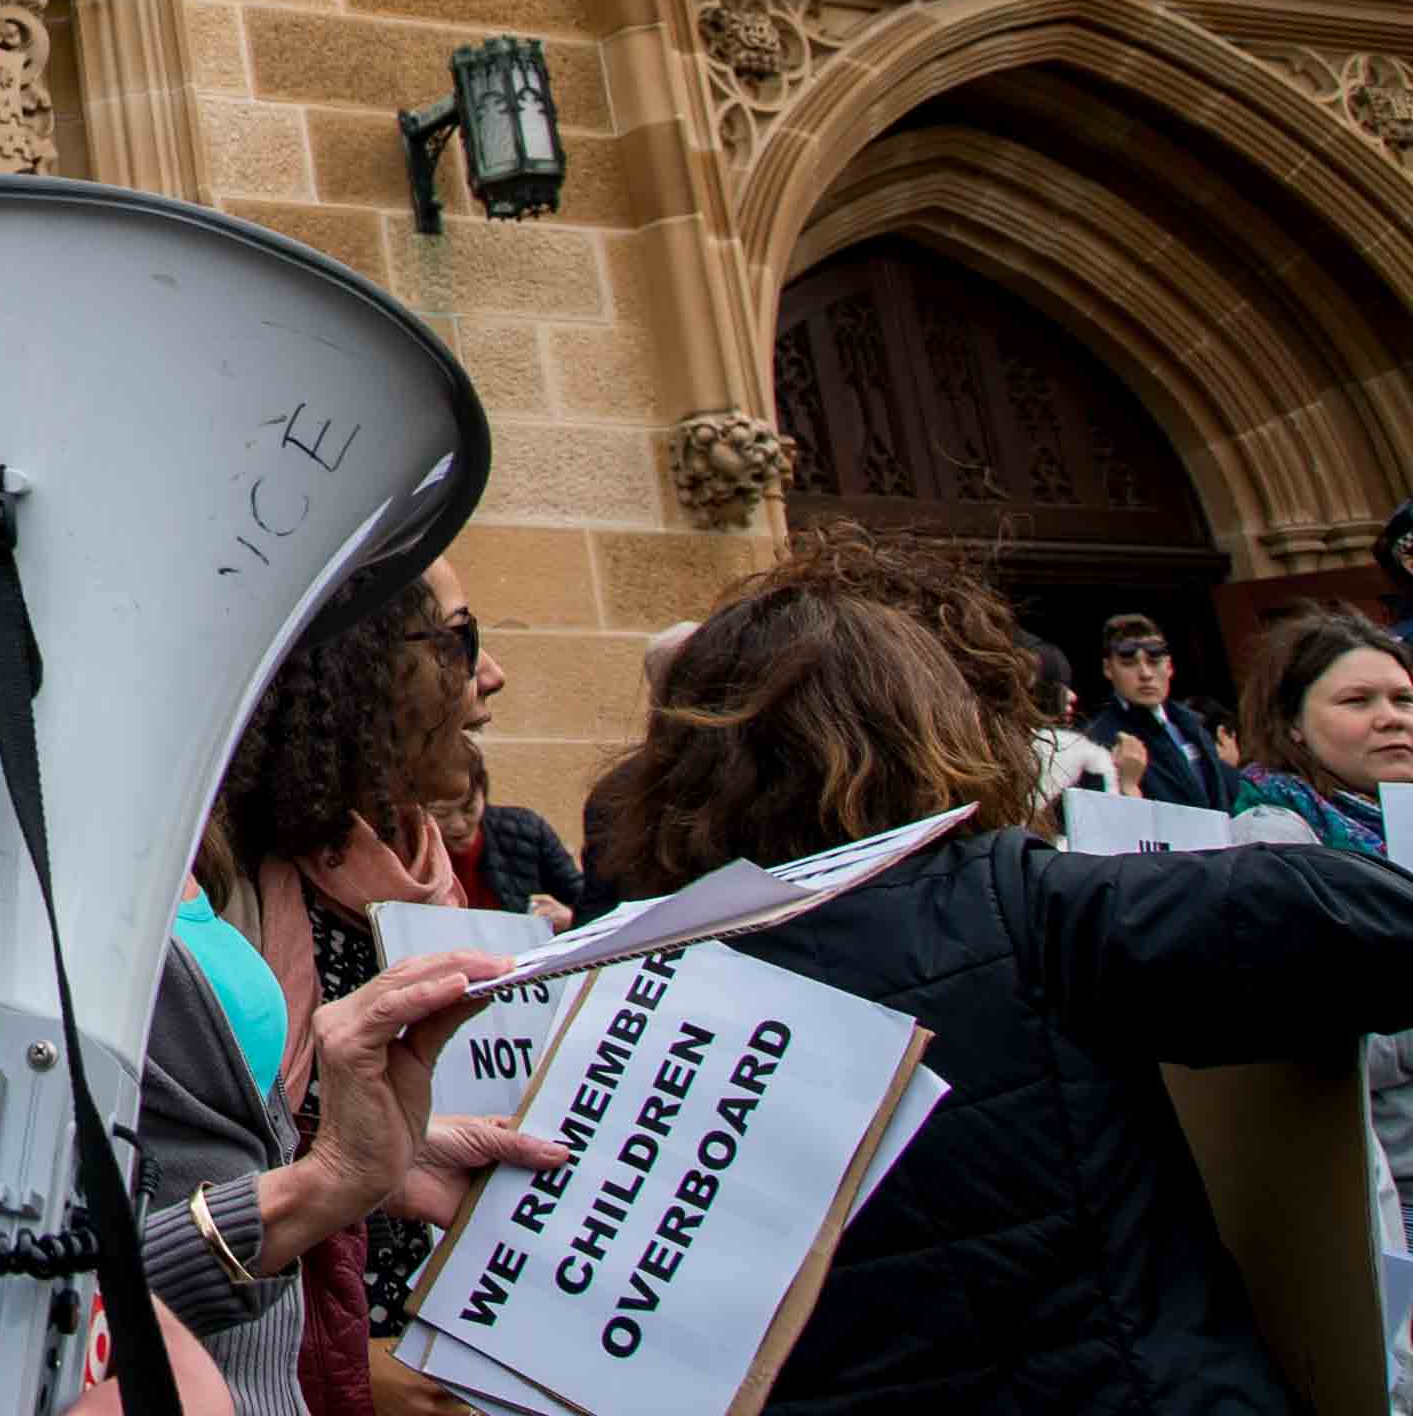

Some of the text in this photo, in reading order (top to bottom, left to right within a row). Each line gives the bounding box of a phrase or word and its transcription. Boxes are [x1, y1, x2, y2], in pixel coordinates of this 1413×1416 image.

[460, 1242, 530, 1329] WE
[511, 947, 686, 1235] REMEMBER
[469, 1037, 534, 1081] NOT
[555, 1021, 717, 1297] CHILDREN
[601, 1018, 793, 1359] OVERBOARD
